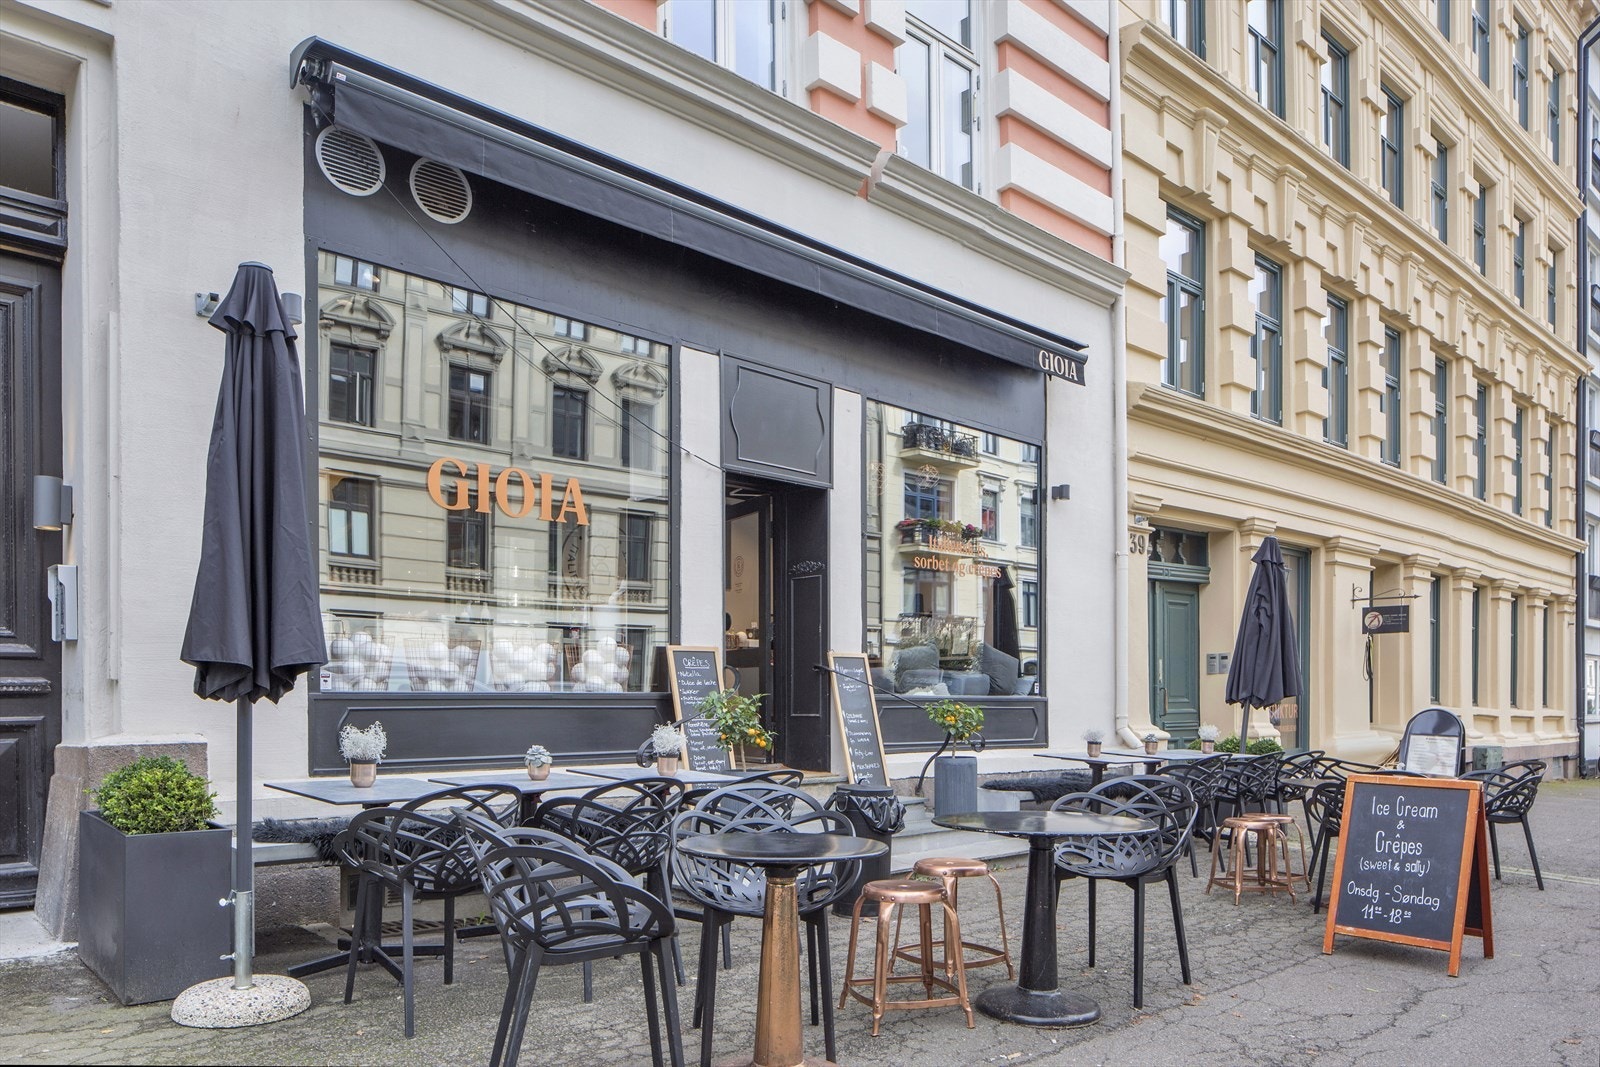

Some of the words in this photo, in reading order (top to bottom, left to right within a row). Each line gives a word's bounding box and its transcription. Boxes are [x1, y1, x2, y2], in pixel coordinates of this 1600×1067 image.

[1039, 350, 1078, 381] GIOIA
[427, 457, 589, 526] GIOIA
[1130, 533, 1145, 555] 39
[914, 555, 949, 572] sorbet
[1371, 796, 1390, 815] Ice
[1396, 795, 1438, 818] Cream
[1396, 820, 1405, 829] &
[1375, 830, 1423, 859] Crêpes
[1360, 857, 1392, 871] (sweet
[1393, 863, 1400, 871] &
[1347, 881, 1379, 903] Onsdg
